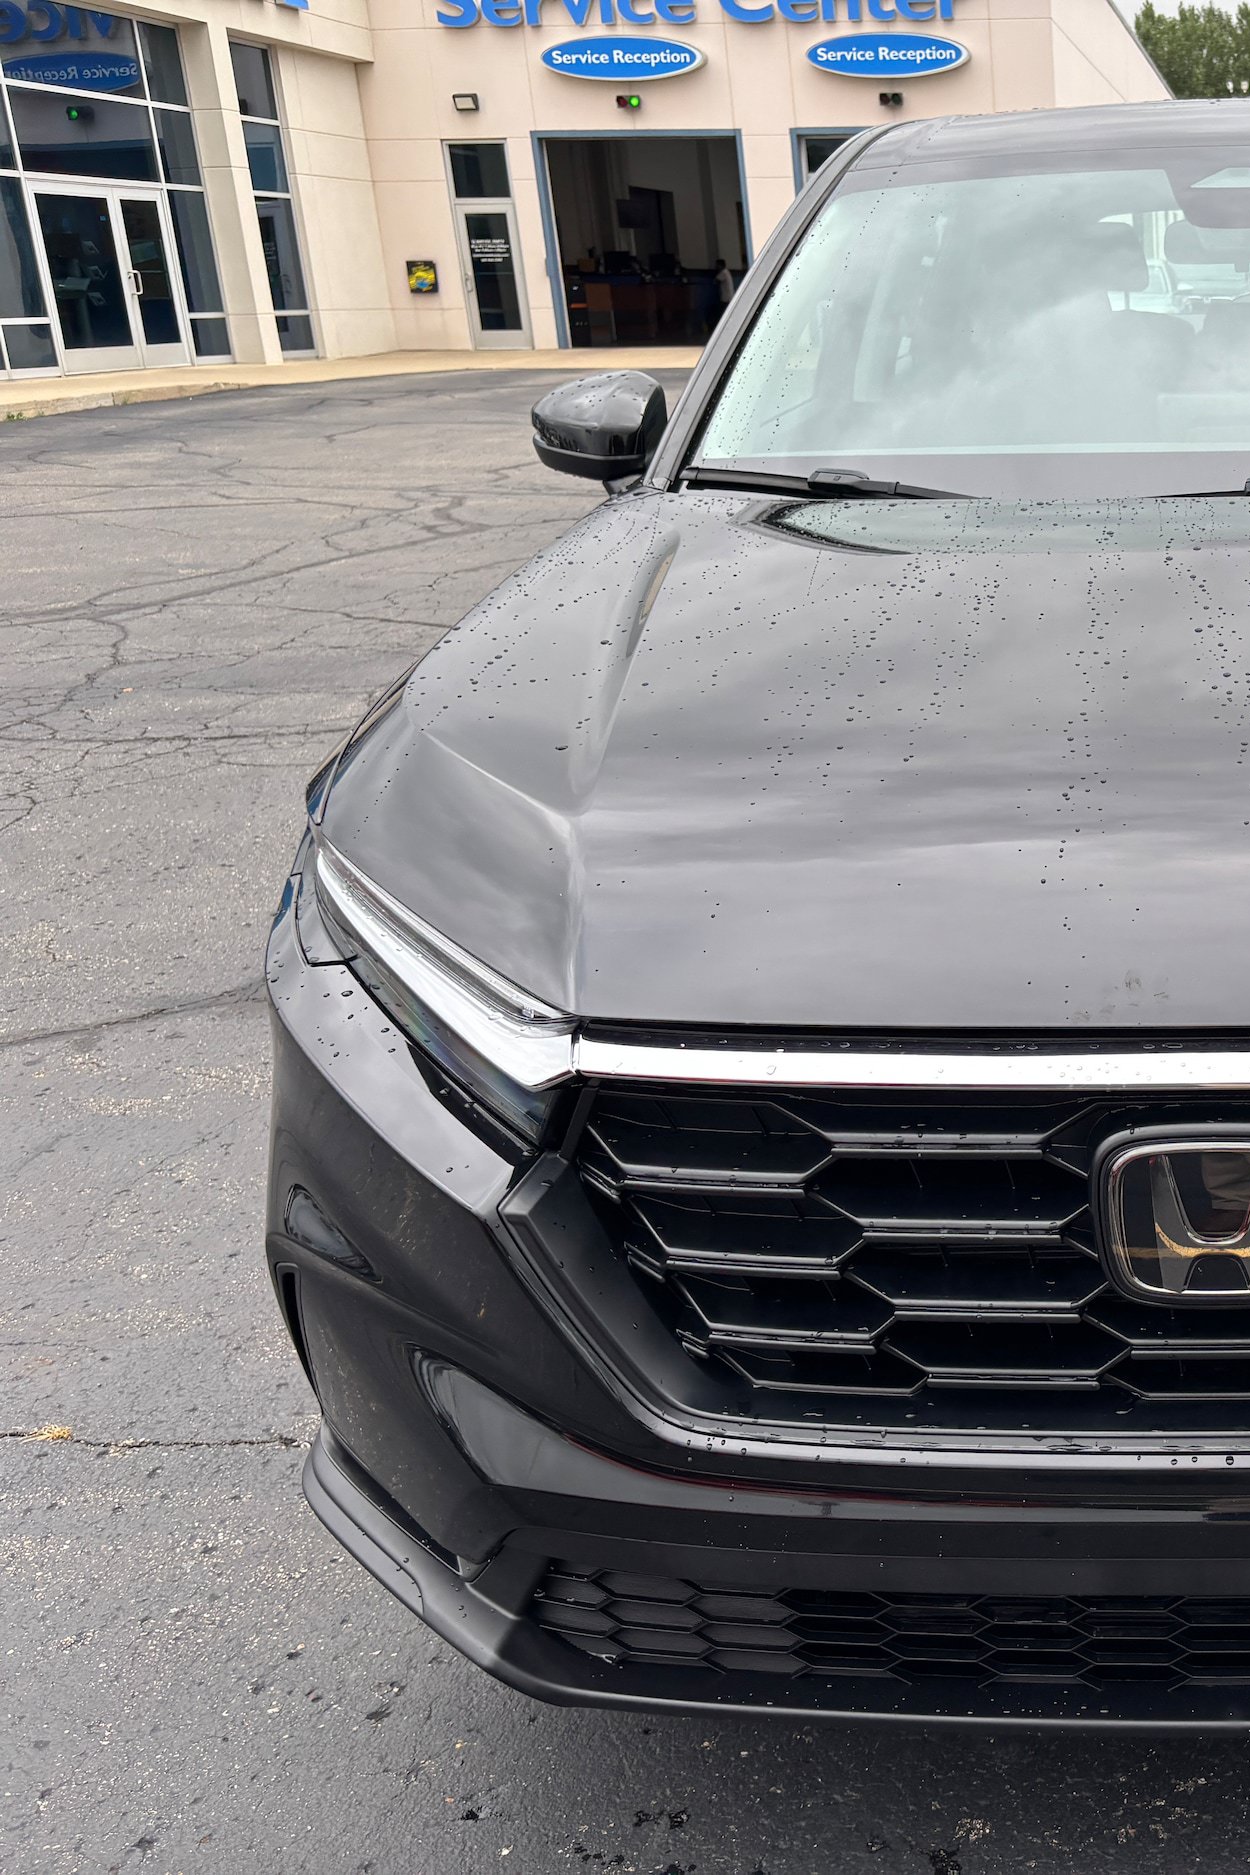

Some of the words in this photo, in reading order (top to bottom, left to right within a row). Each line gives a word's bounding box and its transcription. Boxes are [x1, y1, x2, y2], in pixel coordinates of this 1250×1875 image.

[437, 0, 696, 27] Service
[552, 50, 609, 65] Service
[615, 50, 691, 67] Reception
[816, 47, 874, 62] Service
[878, 46, 956, 64] Reception
